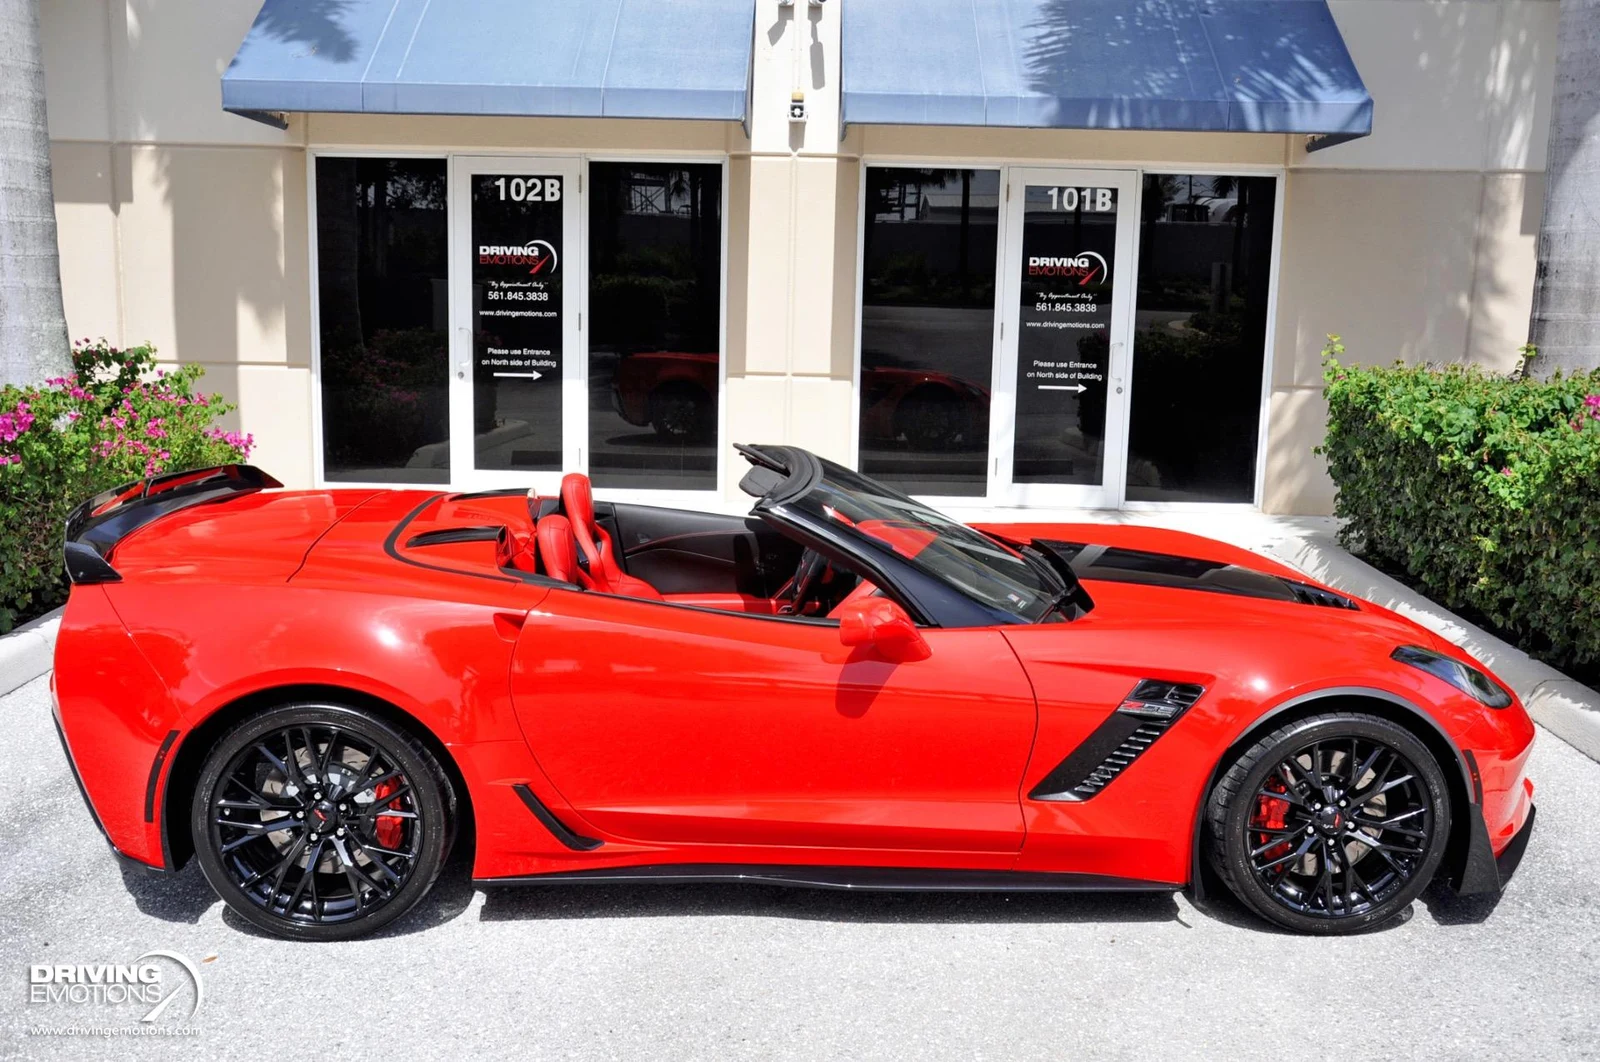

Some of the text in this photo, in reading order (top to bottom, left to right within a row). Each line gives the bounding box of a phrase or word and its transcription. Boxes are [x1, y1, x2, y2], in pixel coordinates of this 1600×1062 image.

[494, 177, 561, 202] 102B
[1047, 187, 1112, 212] 101B
[479, 245, 539, 256] DRIVING
[479, 255, 539, 265] EMOTIONS
[1029, 256, 1089, 267] DRIVING
[1028, 266, 1088, 277] EMOTIONS
[500, 281, 532, 289] Appointment
[487, 291, 549, 301] 561.845.3838
[1048, 292, 1080, 300] Appointment
[1035, 302, 1097, 313] 561.845.3838
[479, 310, 558, 318] www.drivingemotions.com
[1026, 321, 1105, 330] www.drivingemotions.com
[487, 347, 509, 355] Please
[491, 358, 509, 366] North
[531, 359, 557, 368] Building
[1069, 361, 1097, 369] Entrance
[1077, 373, 1103, 382] Building
